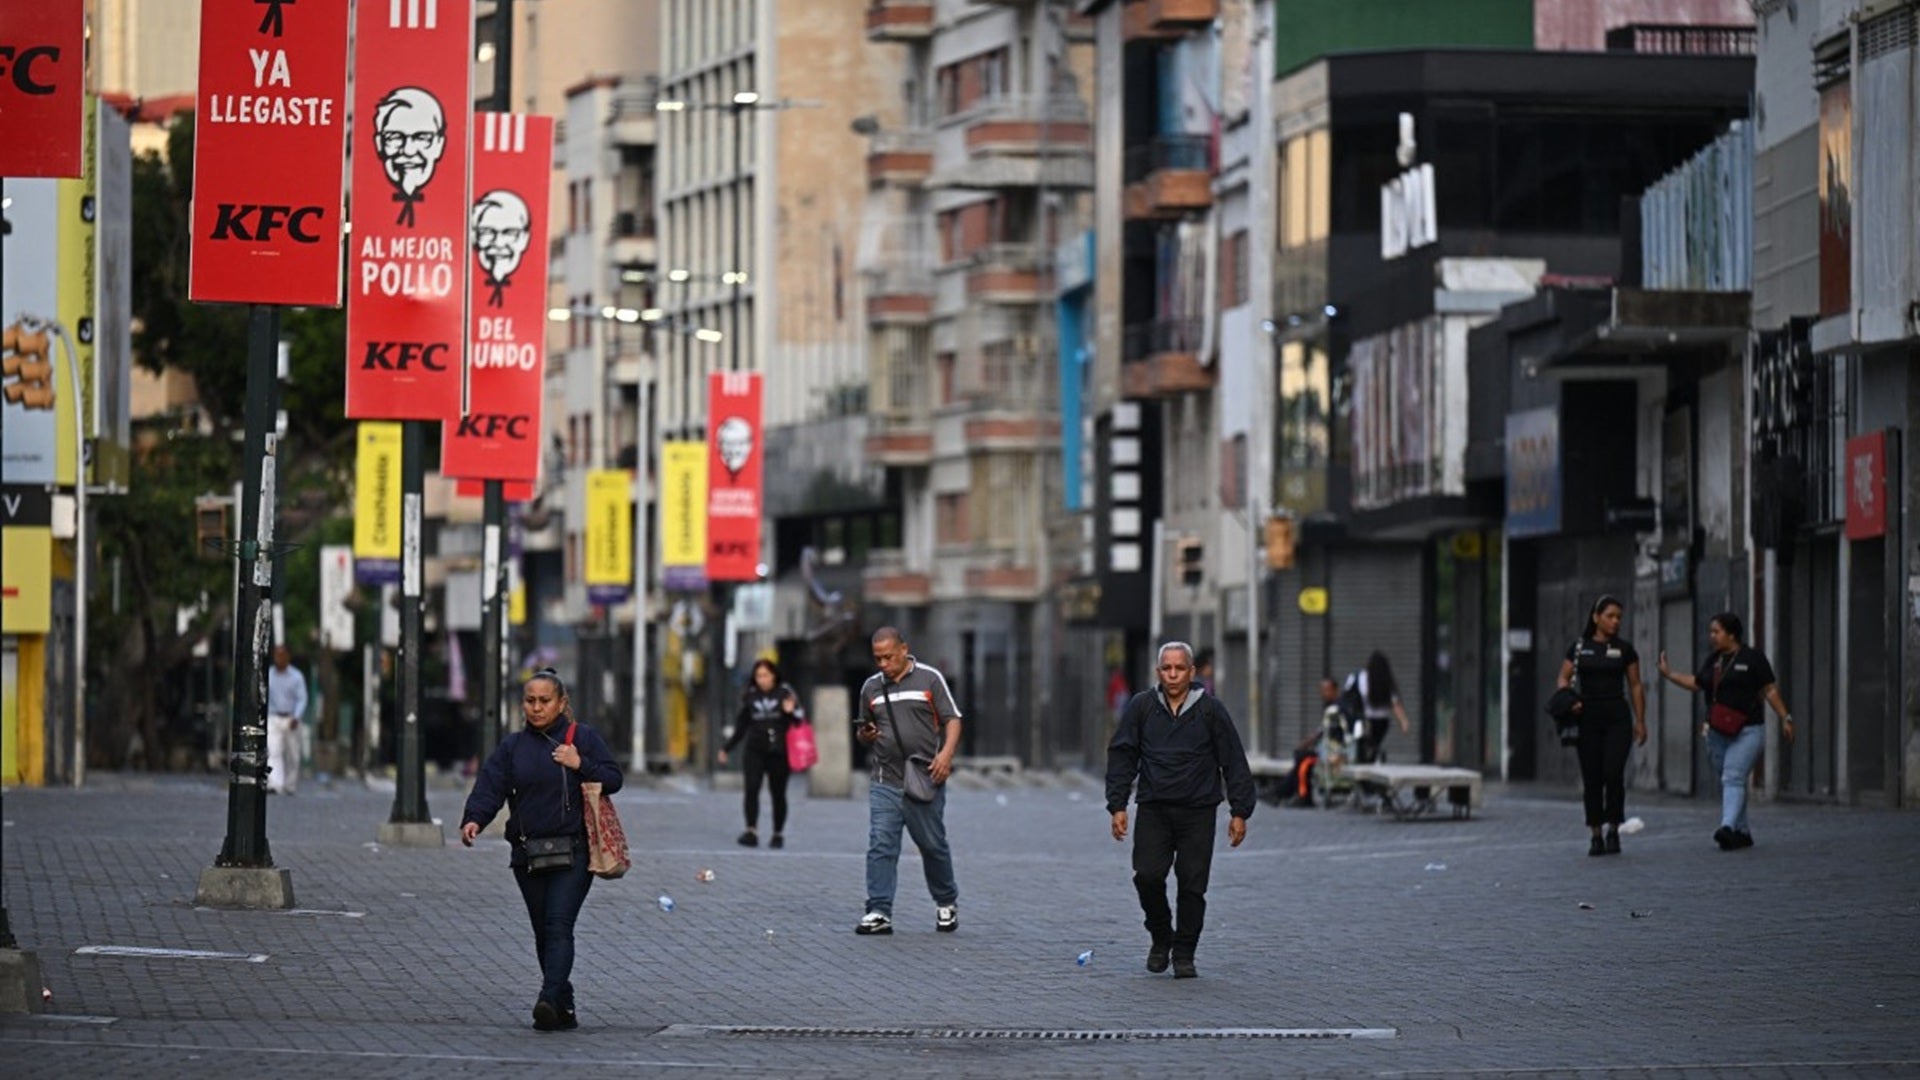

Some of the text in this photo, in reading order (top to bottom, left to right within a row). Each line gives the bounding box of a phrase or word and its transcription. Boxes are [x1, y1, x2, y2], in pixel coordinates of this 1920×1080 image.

[249, 49, 291, 88] YA
[210, 94, 333, 126] LLEGASTE
[209, 204, 324, 242] KFC
[361, 237, 453, 261] AL MEJOR
[361, 262, 452, 297] POLLO
[479, 317, 515, 341] DEL
[360, 342, 448, 372] KFC
[468, 341, 536, 371] UNDO
[456, 414, 530, 440] KFC
